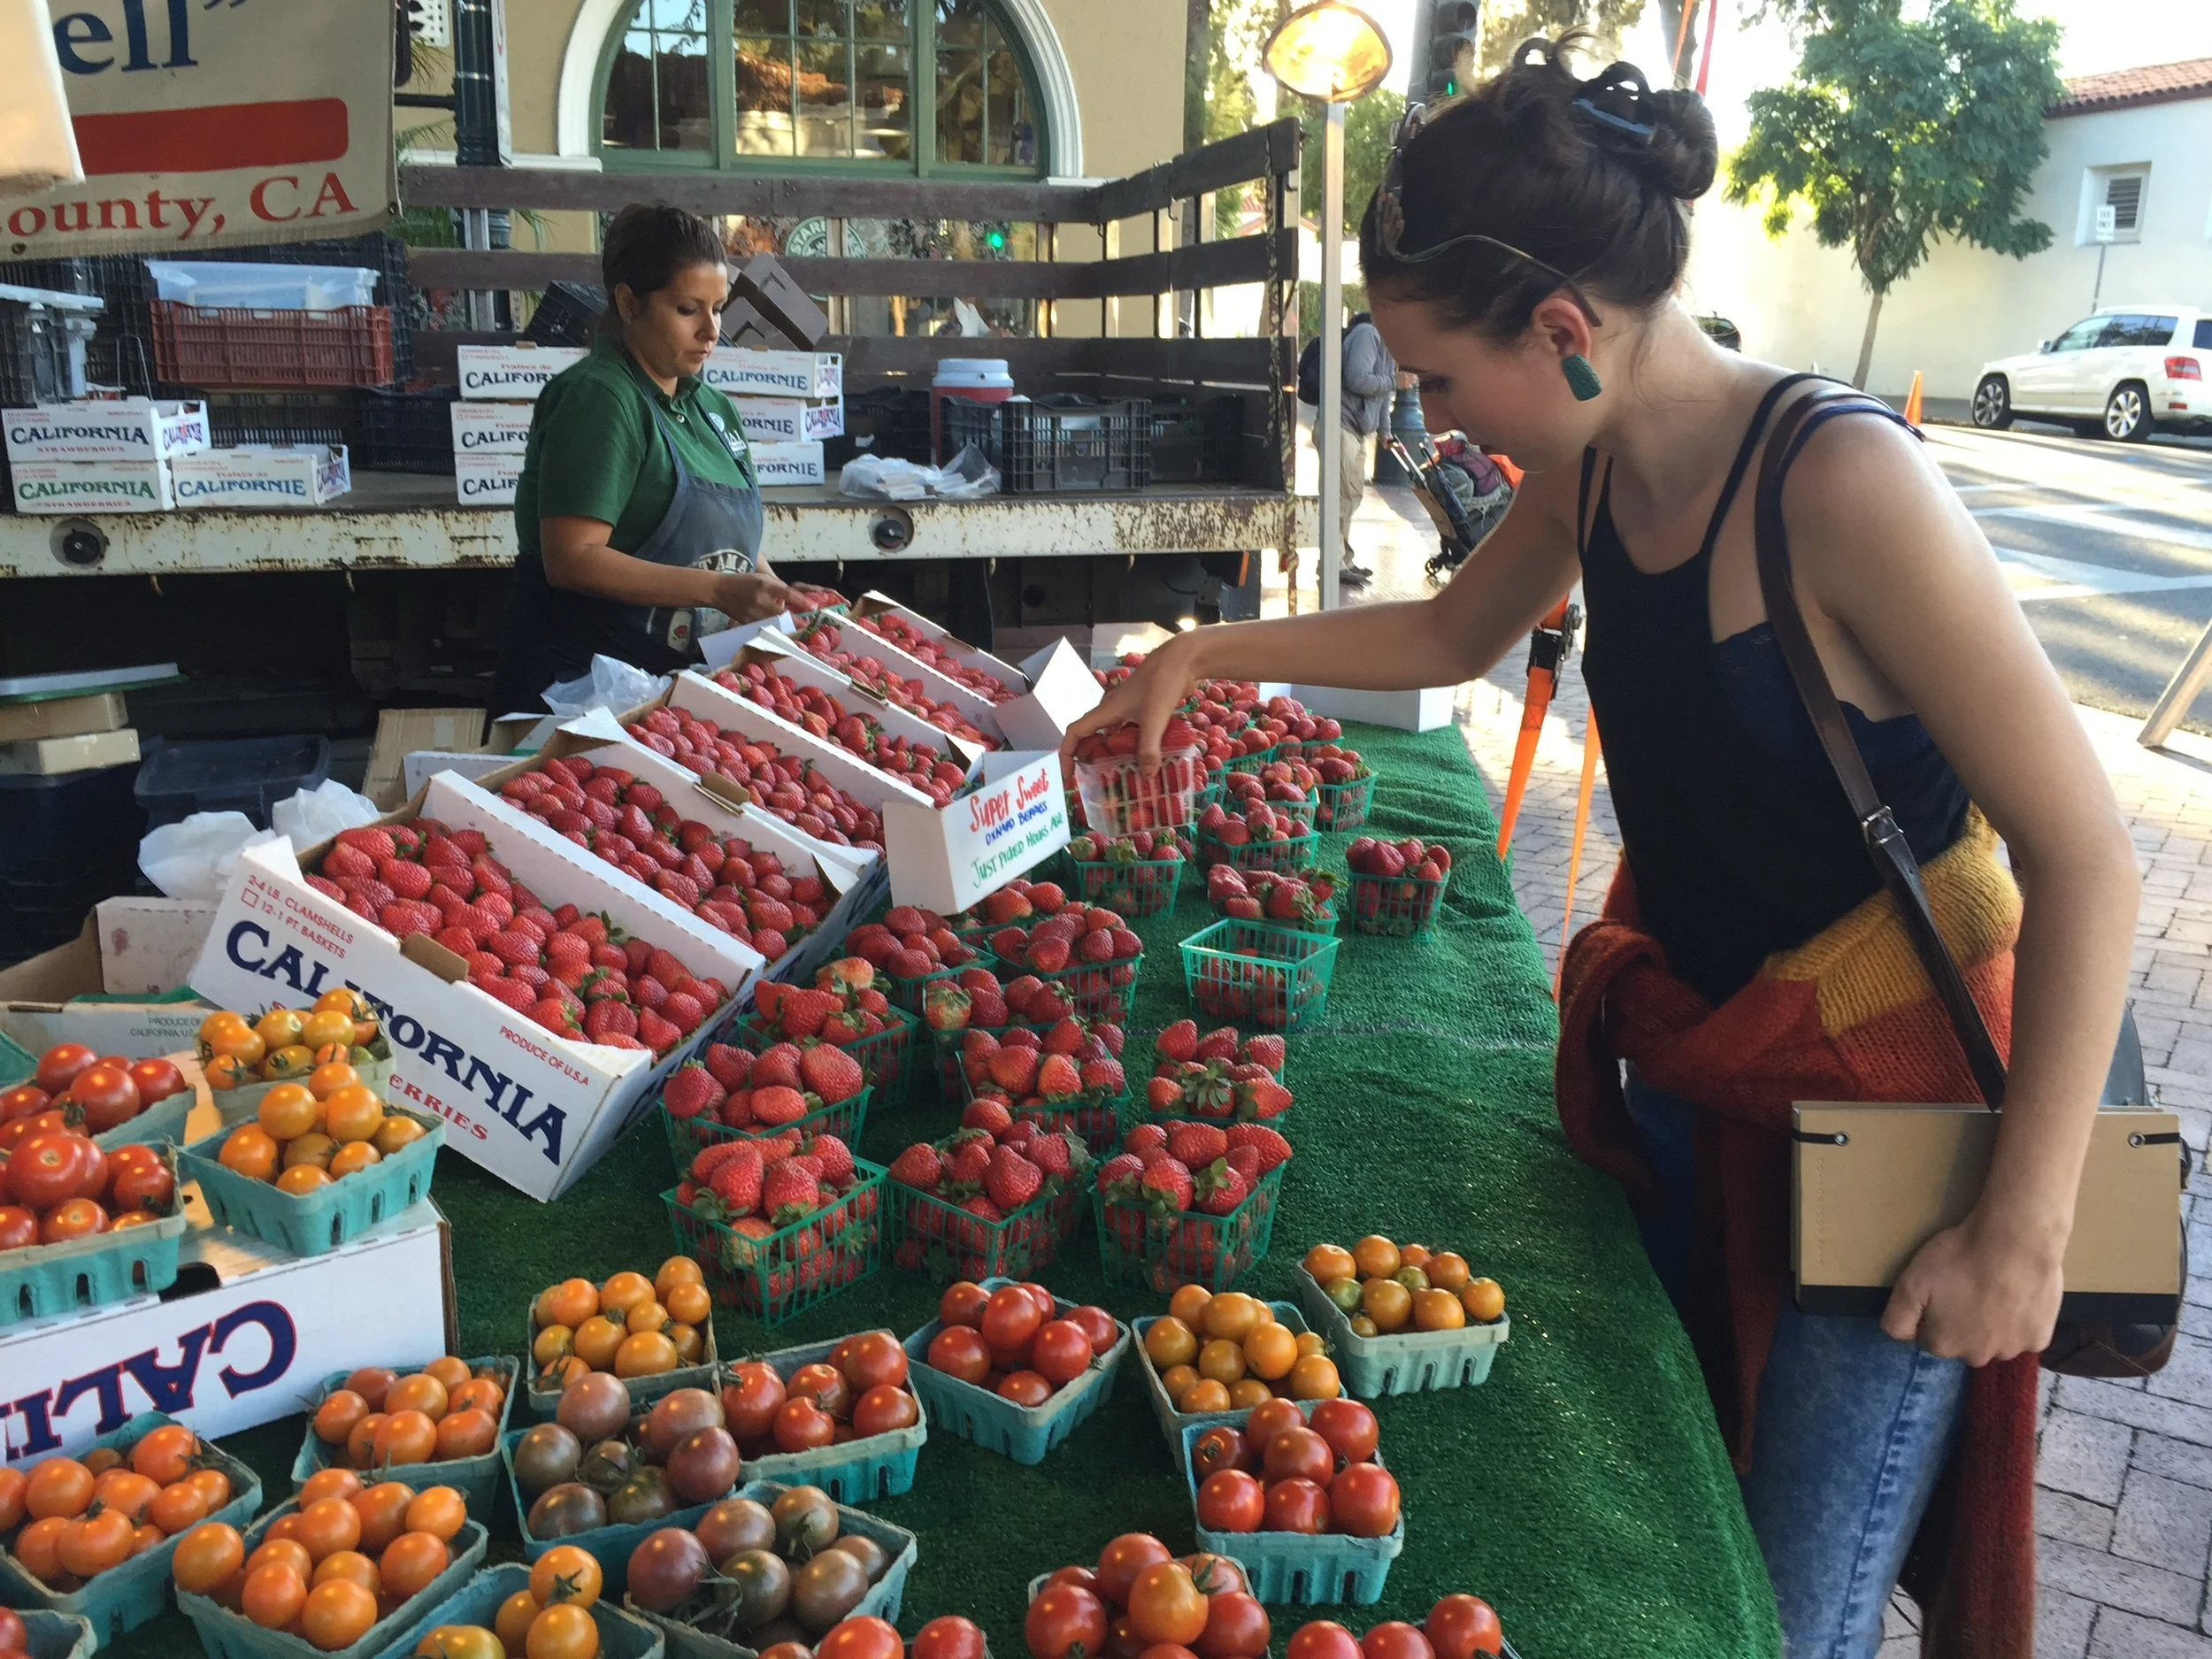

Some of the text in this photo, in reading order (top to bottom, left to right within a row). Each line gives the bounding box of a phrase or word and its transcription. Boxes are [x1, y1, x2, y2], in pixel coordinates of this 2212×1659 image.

[0, 171, 359, 242] ounty, CA
[465, 372, 561, 389] CALIFOR
[707, 369, 808, 391] CALIFORNIE
[11, 426, 150, 446] CALIFORNIA
[741, 419, 795, 436] ORNIE
[461, 431, 529, 449] CALIFO
[756, 462, 818, 478] FORNIE
[18, 480, 156, 501] CALIFORNIA
[178, 479, 307, 498] CALIFORNIE
[463, 479, 519, 496] CALIF
[248, 875, 354, 945] 2-4 LB. CLAMSHELLS
[300, 926, 347, 959] BASKETS
[148, 1018, 189, 1027] PRODUCE
[227, 920, 568, 1167] CALFORNIA
[499, 1025, 548, 1062] PRODUCE
[548, 1056, 564, 1073] OF
[389, 1073, 489, 1141] ERRIES
